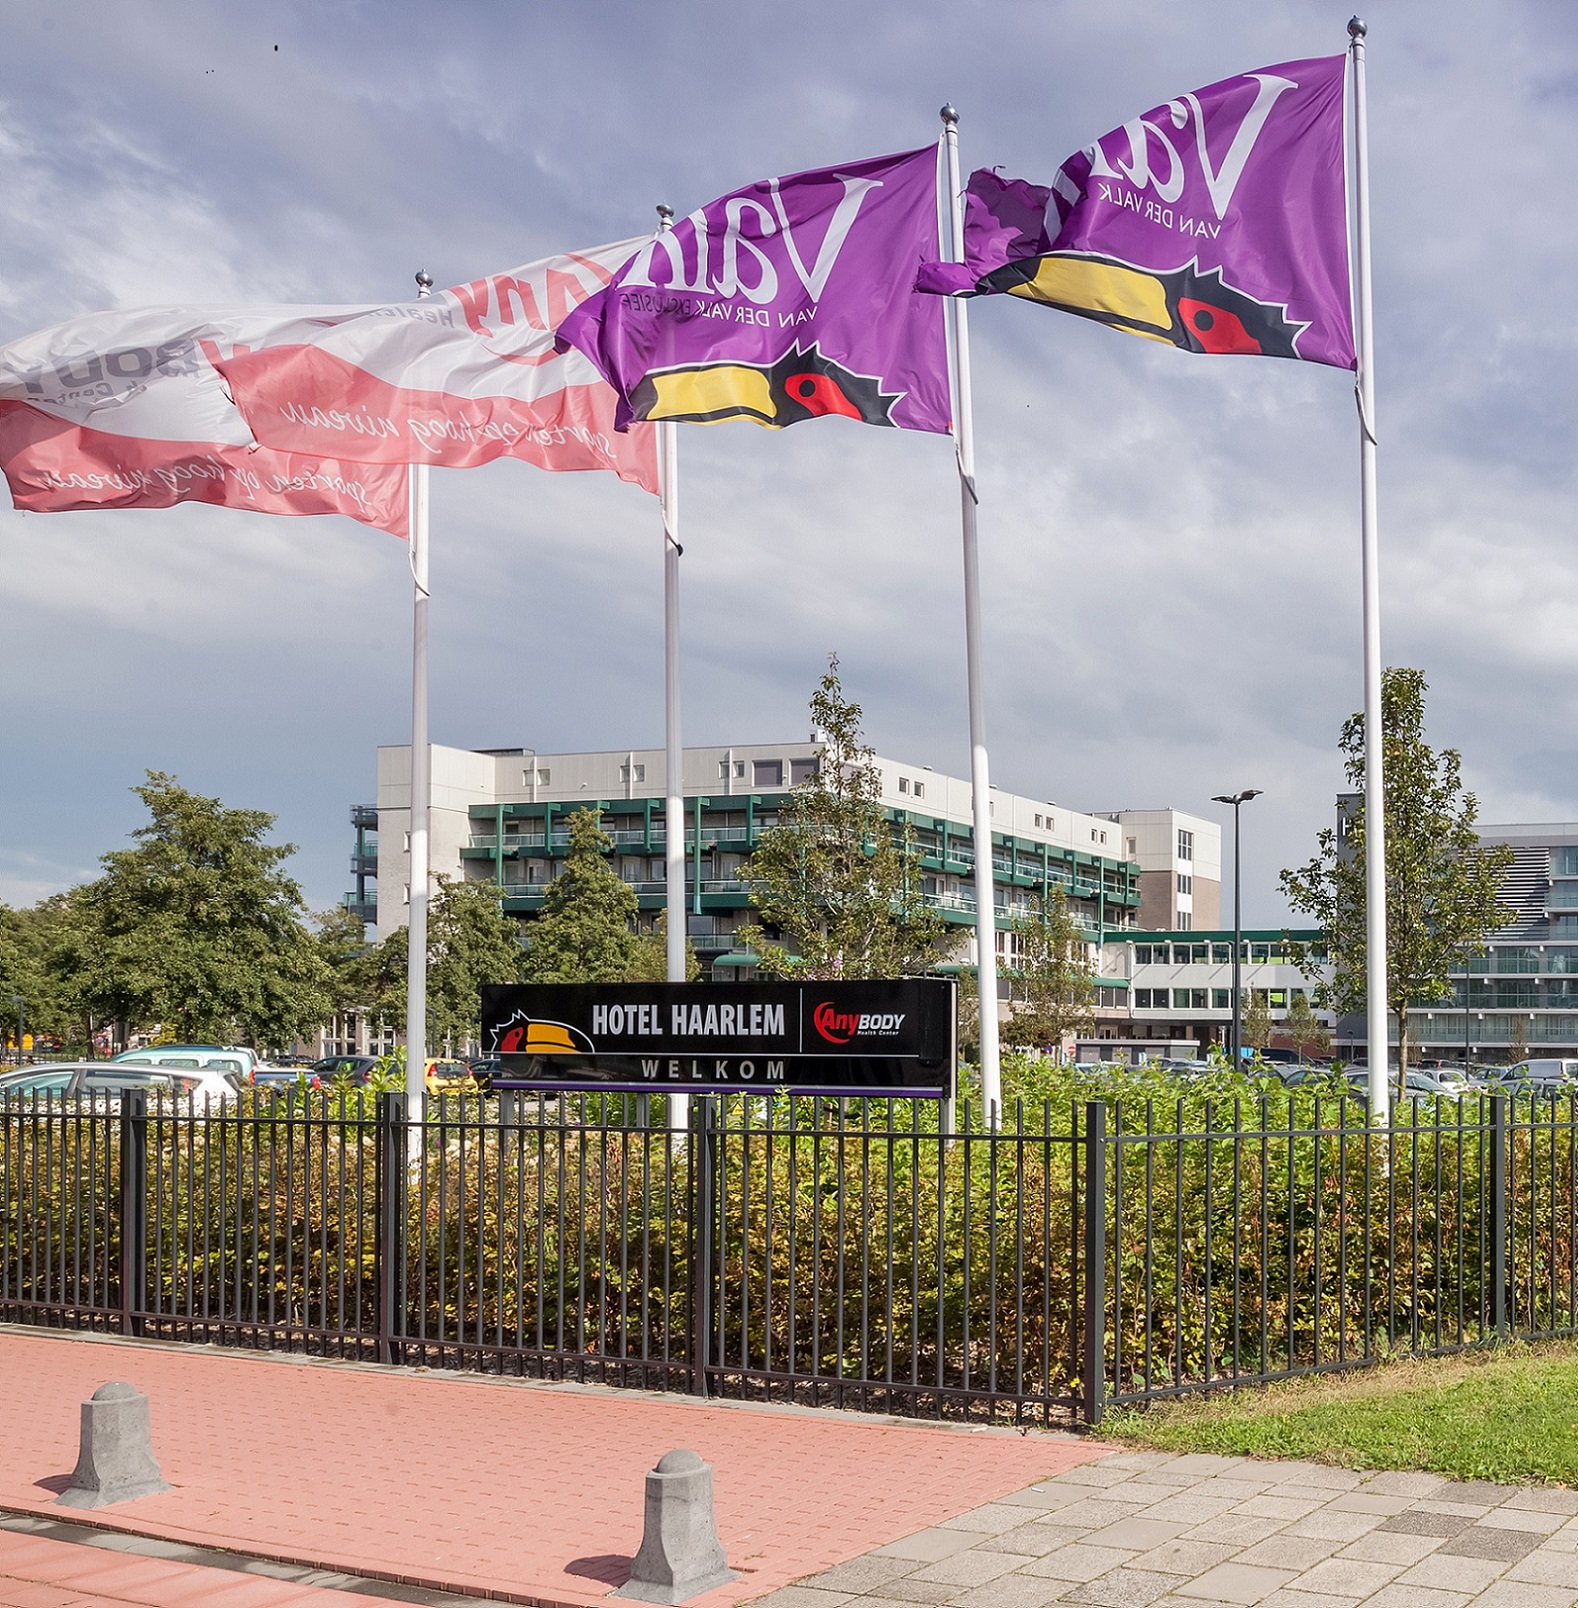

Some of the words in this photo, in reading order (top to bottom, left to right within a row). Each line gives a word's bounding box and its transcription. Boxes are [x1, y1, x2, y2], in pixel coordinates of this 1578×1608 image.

[592, 1004, 664, 1036] HOTEL
[671, 1004, 785, 1036] HAARLEM
[641, 1059, 785, 1080] WELKOM
